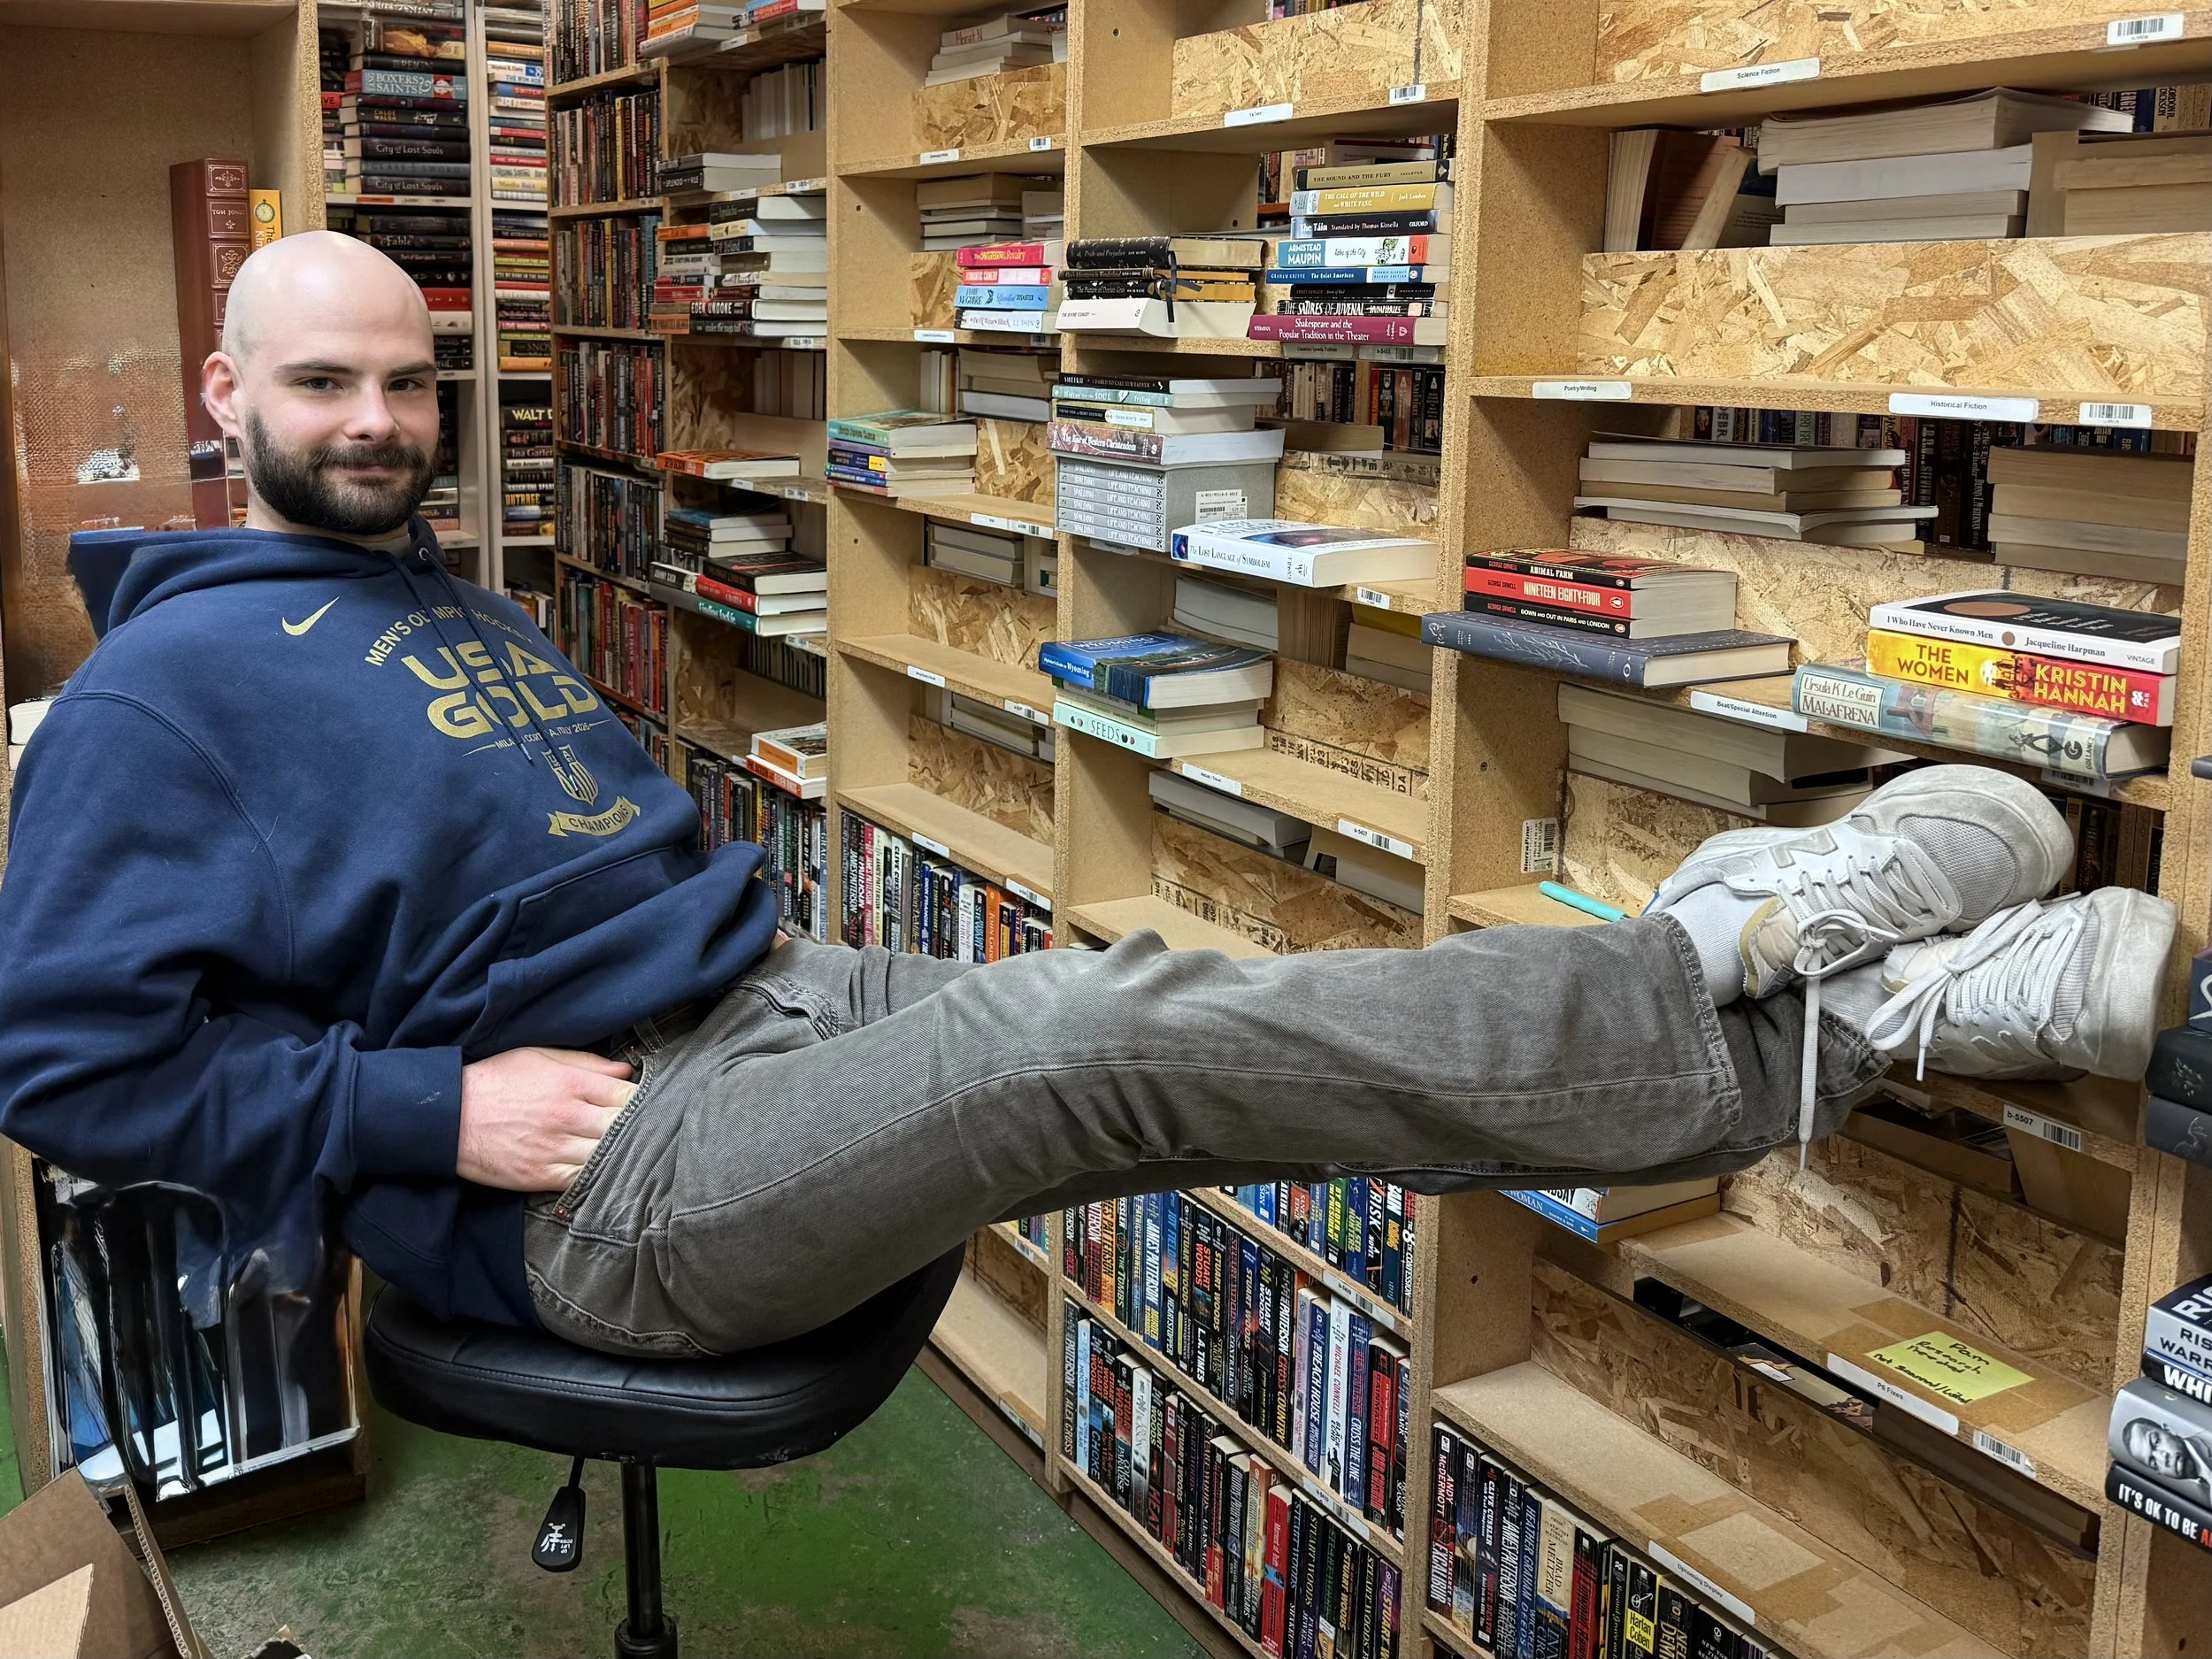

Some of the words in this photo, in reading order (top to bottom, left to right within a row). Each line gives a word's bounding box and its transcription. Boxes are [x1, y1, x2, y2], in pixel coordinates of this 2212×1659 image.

[376, 74, 419, 84] BOXERS
[1737, 69, 1760, 80] Science
[1762, 66, 1781, 76] Fiction
[377, 83, 420, 94] SAINTS
[376, 145, 393, 154] City
[403, 145, 419, 154] Lost
[422, 146, 443, 155] Souls
[266, 225, 276, 244] The
[1300, 224, 1312, 233] The
[1313, 222, 1328, 232] Táin
[1355, 222, 1361, 231] by
[1362, 221, 1379, 230] Thomas
[1380, 220, 1399, 229] Kinsella
[1287, 252, 1322, 265] MAUPIN
[1288, 242, 1322, 253] ARMISTEAD
[1284, 300, 1297, 316] THE
[1298, 300, 1324, 316] SATIRES
[1325, 302, 1335, 316] OF
[1334, 302, 1364, 316] JUVENAL
[1279, 329, 1300, 340] Popular
[1300, 329, 1326, 339] Tradition
[1328, 330, 1333, 339] in
[1334, 331, 1345, 340] the
[1346, 331, 1370, 342] Theater
[1294, 319, 1329, 329] Shakespeare
[1331, 319, 1341, 328] and
[1342, 319, 1353, 328] the
[512, 409, 545, 421] WALT
[1931, 400, 1962, 409] Historical
[1963, 402, 1987, 411] Fiction
[1530, 566, 1555, 577] ANIMAL
[1555, 571, 1573, 580] FARM
[1524, 581, 1556, 599] NINETEEN
[1558, 587, 1601, 607] EIGHTY-FOUR
[1521, 609, 1537, 618] DOWN
[1892, 616, 1908, 626] Who
[1909, 618, 1925, 630] Have
[1928, 621, 1947, 633] Never
[1949, 625, 1972, 637] Known
[1975, 629, 1993, 640] Men
[365, 621, 411, 666] MEN'S
[1916, 644, 1952, 664] THE
[2024, 636, 2066, 655] Jacqueline
[2067, 642, 2106, 658] Harpman
[401, 641, 560, 689] USA
[1066, 662, 1090, 678] Wyoming
[1897, 658, 1970, 685] WOMEN
[2127, 654, 2155, 664] VINTAGE
[1803, 678, 1832, 694] Ursula
[1843, 685, 1855, 697] Le
[1855, 687, 1877, 703] Guin
[2035, 664, 2127, 694] KRISTIN
[426, 676, 598, 740] GOLD
[1802, 695, 1877, 726] MALAFRENA
[2034, 682, 2126, 714] HANNAH
[1752, 706, 1778, 719] Attention
[1091, 720, 1120, 742] SEEDS
[569, 805, 629, 832] CHAMPIONS
[849, 872, 858, 913] PATTERSON
[2007, 1110, 2033, 1125] b-5507
[1147, 1218, 1160, 1247] JAMES
[1145, 1247, 1160, 1305] PATTERSON
[1405, 1252, 1415, 1297] CONFESSION
[1279, 1303, 1290, 1356] PATTERSON
[1333, 1345, 1342, 1377] MICHAEL
[1949, 1342, 1990, 1365] Pam
[1279, 1355, 1287, 1389] CROSS
[1313, 1352, 1322, 1385] BEACH
[1310, 1386, 1320, 1425] HOUSE
[1331, 1378, 1341, 1417] CONNELLY
[1887, 1386, 1903, 1400] Fixes
[1277, 1389, 1286, 1443] COUNTRY
[1090, 1430, 1102, 1480] CHOKE
[1436, 1455, 1447, 1518] McDERMOTT
[1446, 1476, 1455, 1505] ANDY
[1148, 1486, 1160, 1538] HEAT
[2119, 1483, 2142, 1509] IT'S
[2146, 1497, 2160, 1519] OK
[2165, 1508, 2178, 1530] TO
[2182, 1517, 2198, 1540] BE
[1525, 1505, 1536, 1550] HEATHER
[1431, 1542, 1448, 1604] EXCALIBUR
[1524, 1552, 1535, 1601] GRAHAM
[1546, 1540, 1556, 1594] MELTZER
[1678, 1563, 1702, 1585] Upcoming
[1704, 1581, 1723, 1599] Display
[1519, 1603, 1529, 1646] DEEDS
[1630, 1612, 1651, 1636] Harlan
[1630, 1626, 1650, 1650] Coben
